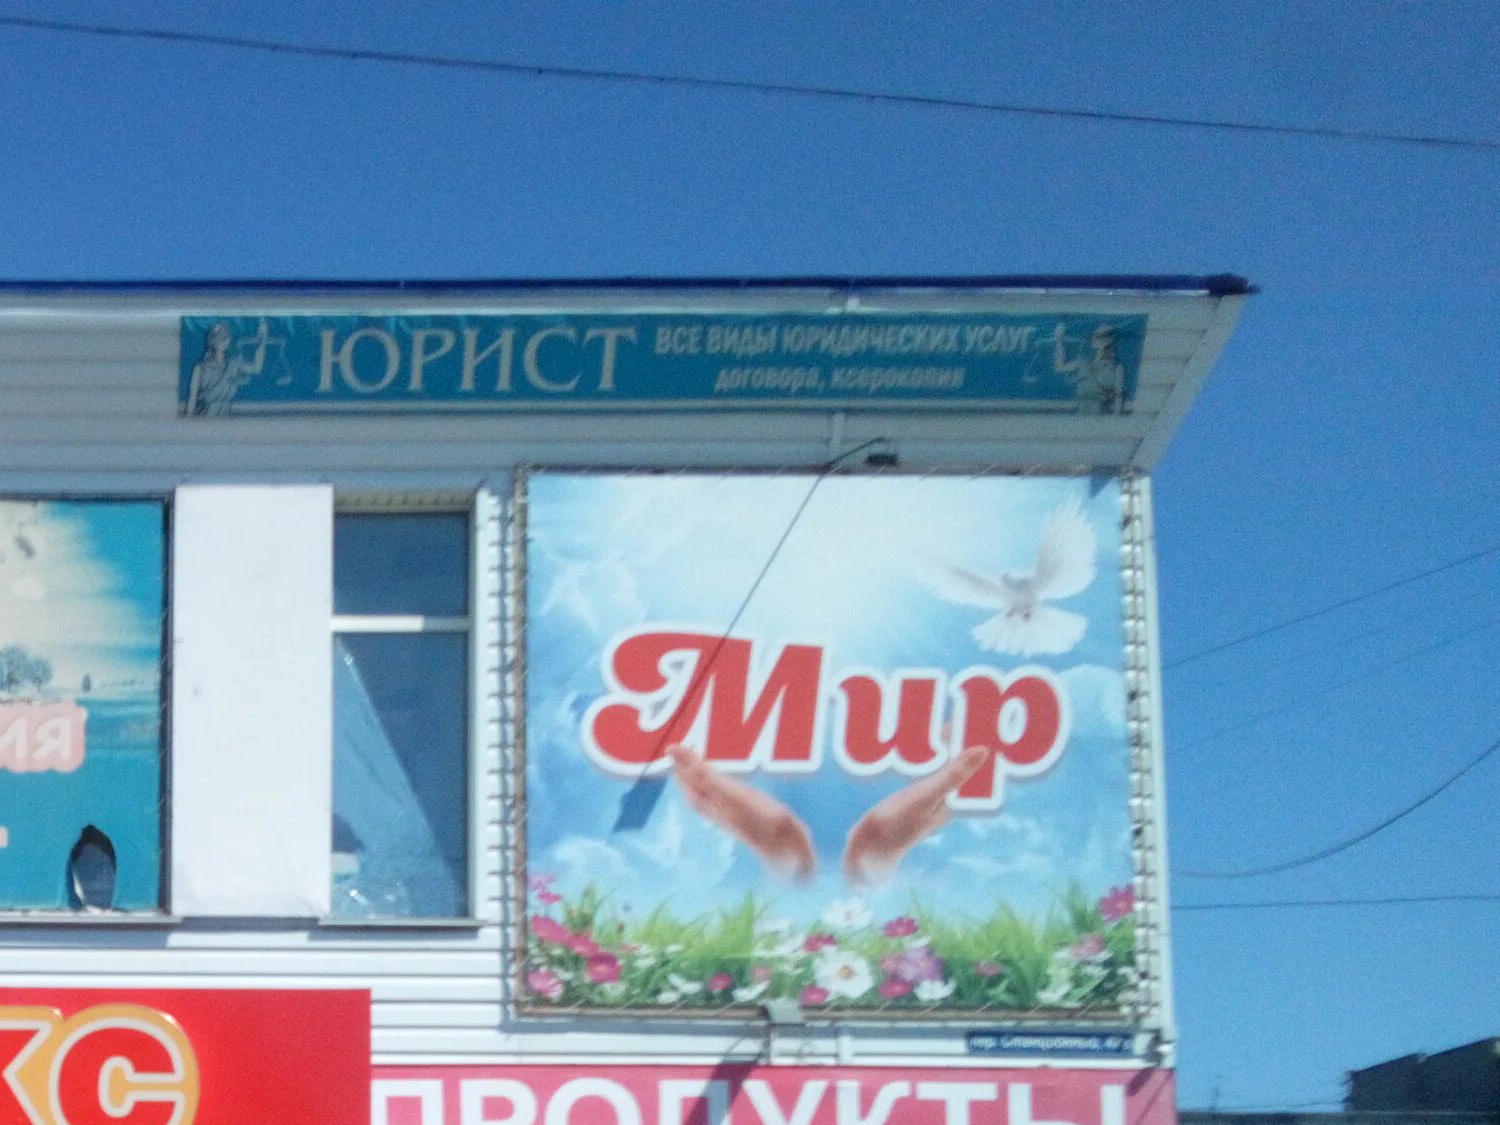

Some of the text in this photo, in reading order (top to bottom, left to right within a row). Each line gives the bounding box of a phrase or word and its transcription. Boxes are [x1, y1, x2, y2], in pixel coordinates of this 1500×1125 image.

[316, 327, 638, 394] ЮРИСТ
[654, 325, 703, 354] ВСЕ
[706, 325, 778, 357] ВИДЫ
[782, 324, 958, 357] ЮРИДИЧЕСКИХ
[591, 631, 1062, 799] Мир
